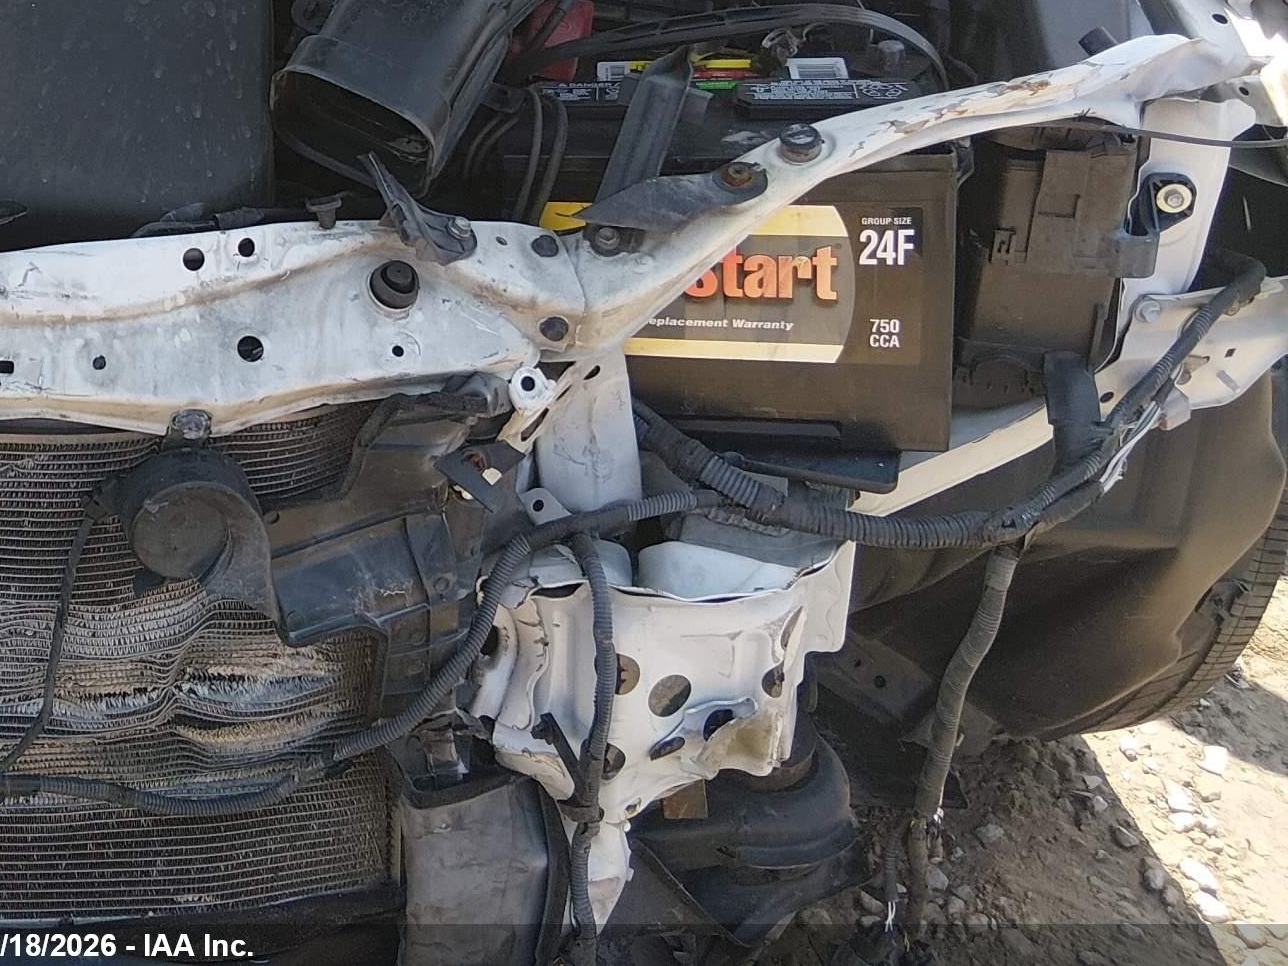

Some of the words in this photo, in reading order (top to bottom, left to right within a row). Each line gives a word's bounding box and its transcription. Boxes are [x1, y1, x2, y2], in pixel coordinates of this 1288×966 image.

[861, 217, 891, 226] GROUP
[893, 217, 912, 226] SIZE
[858, 229, 916, 266] 24F
[648, 316, 729, 328] eplacement
[732, 319, 795, 331] Warranty
[870, 318, 900, 333] 750
[869, 334, 900, 348] CCA
